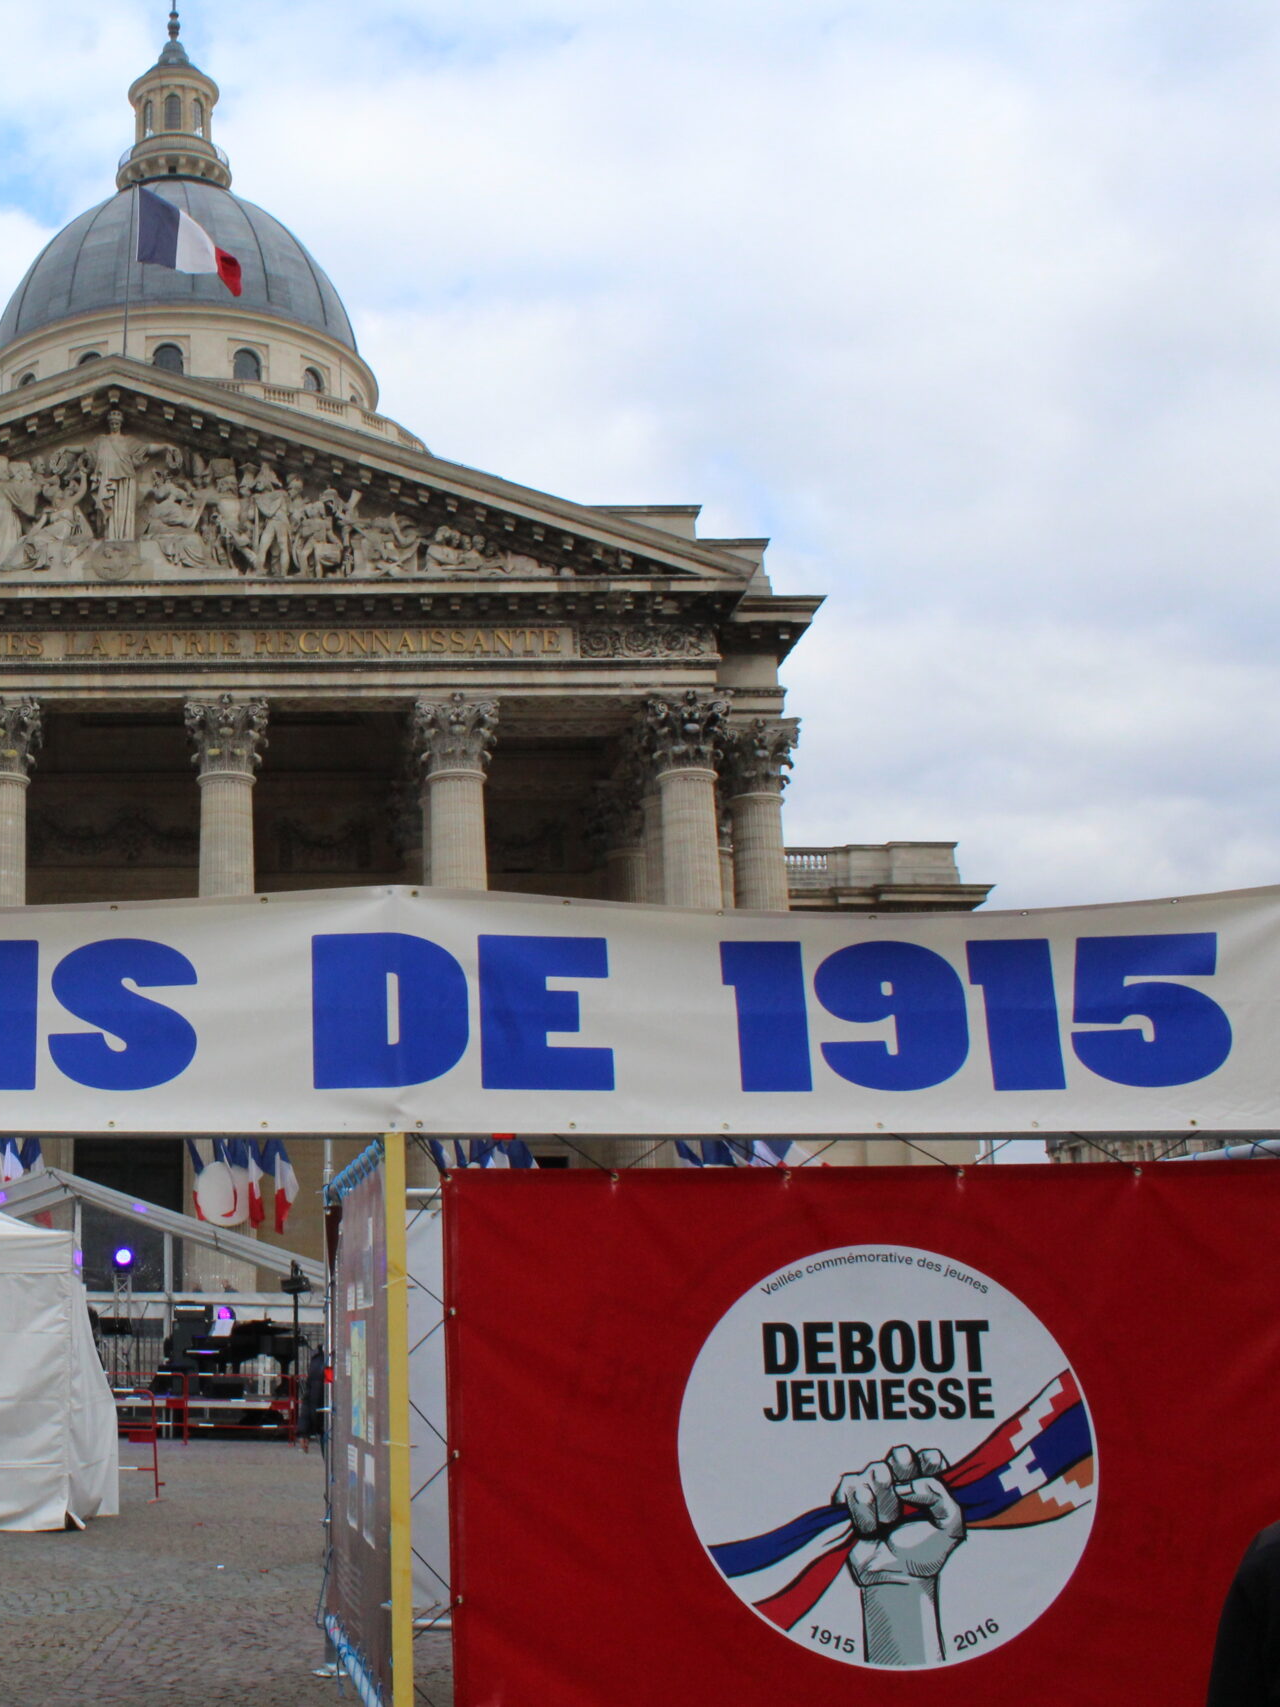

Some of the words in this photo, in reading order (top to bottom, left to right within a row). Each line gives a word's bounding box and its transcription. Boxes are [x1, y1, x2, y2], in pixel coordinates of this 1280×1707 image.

[65, 632, 110, 657] LA
[118, 631, 241, 656] PATRIE
[252, 628, 562, 655] RECONNAISSANTE
[313, 932, 617, 1092] DE
[721, 932, 1233, 1093] 1915
[760, 1269, 804, 1296] Veillée
[805, 1252, 914, 1275] commémorative
[916, 1257, 942, 1273] des
[943, 1264, 990, 1295] jeunes
[762, 1319, 990, 1375] DEBOUT
[763, 1377, 996, 1422] JEUNESSE
[809, 1624, 856, 1655] 1915
[953, 1618, 1000, 1652] 2016
